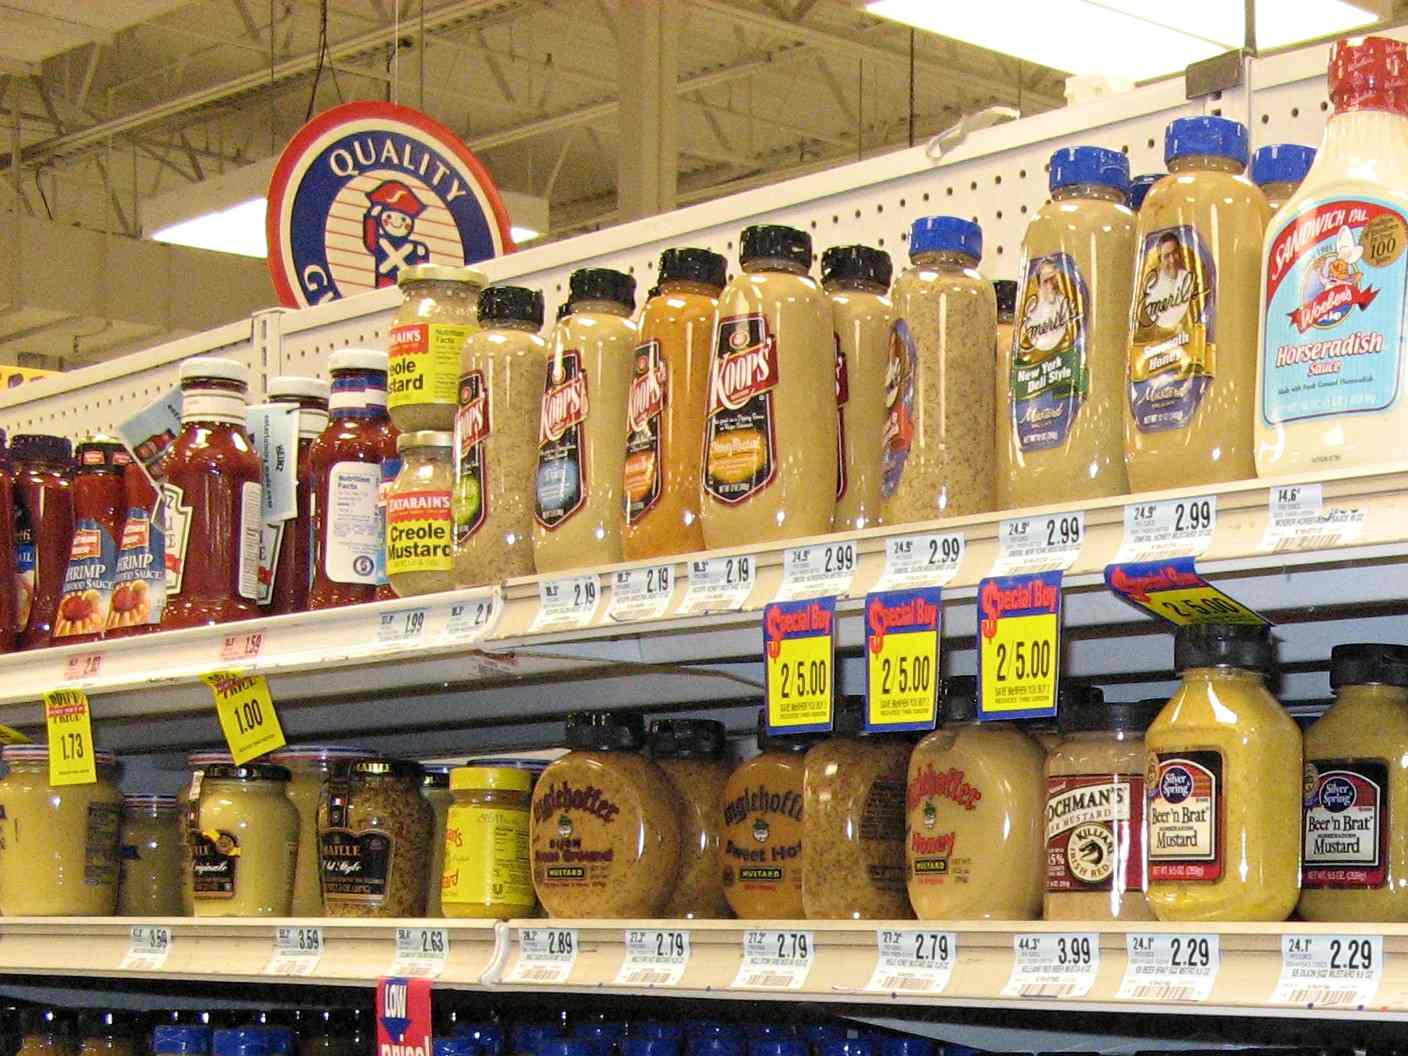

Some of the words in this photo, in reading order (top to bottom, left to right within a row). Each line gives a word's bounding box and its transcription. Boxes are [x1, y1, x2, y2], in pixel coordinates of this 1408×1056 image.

[330, 137, 469, 203] QUALITY
[1272, 208, 1345, 281] SANDWICH
[1276, 332, 1383, 367] Horseradish
[711, 337, 773, 408] KOOPS'
[1308, 360, 1343, 377] Sauce
[1174, 498, 1212, 532] 2.99
[391, 524, 445, 543] Creole
[1046, 517, 1080, 547] 2.99
[824, 544, 854, 573] 2.99
[928, 536, 961, 565] 2.99
[646, 567, 670, 594] 2.19
[725, 558, 750, 584] 2.19
[573, 582, 596, 606] 2.19
[881, 655, 931, 694] 2/5.00
[996, 640, 1051, 682] 2/5.00
[780, 659, 827, 698] 2/5.00
[234, 700, 265, 737] 1.00
[61, 733, 84, 761] 1.73
[1164, 783, 1188, 797] Spring
[1165, 773, 1187, 784] Silver
[1152, 808, 1169, 824] Beer
[1182, 807, 1207, 823] Brat
[1157, 830, 1197, 849] Mustard
[1313, 837, 1360, 855] Mustard
[299, 930, 320, 950] 3.59
[421, 931, 444, 952] 2.63
[548, 932, 573, 954] 2.89
[655, 932, 685, 957] 2.79
[777, 932, 807, 958] 2.79
[915, 934, 949, 961] 2.79
[1057, 937, 1091, 965] 3.99
[1170, 937, 1210, 967] 2.29
[1329, 939, 1373, 969] 2.29
[383, 984, 407, 1018] LOW
